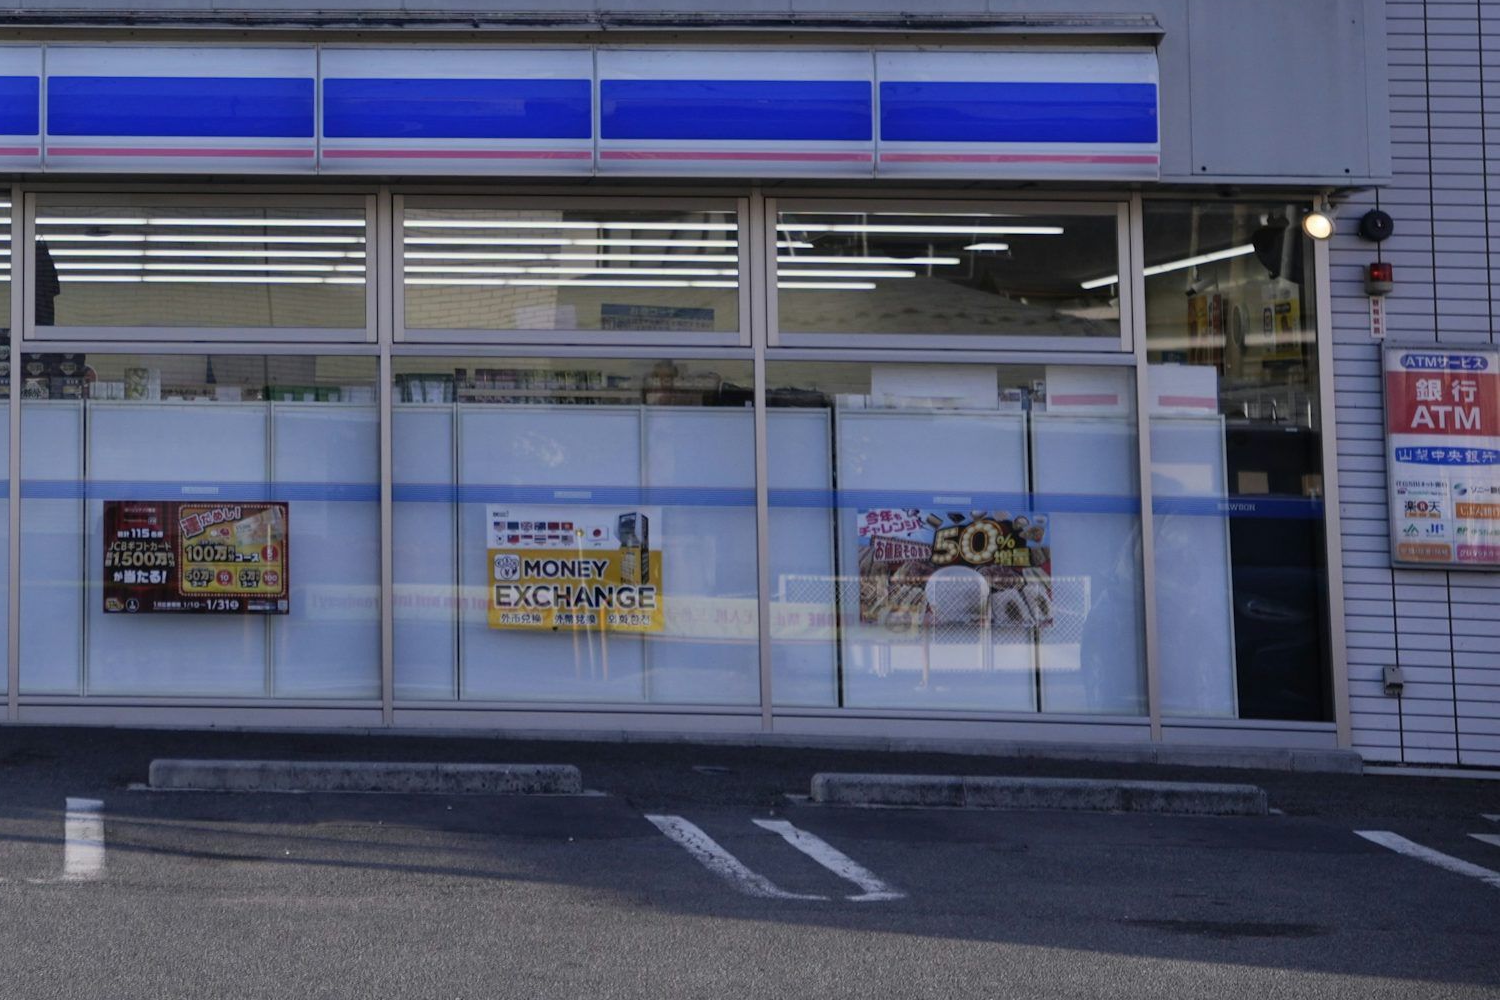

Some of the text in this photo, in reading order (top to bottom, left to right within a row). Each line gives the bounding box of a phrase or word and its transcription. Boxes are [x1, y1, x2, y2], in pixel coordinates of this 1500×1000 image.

[1406, 356, 1484, 369] ATMサービス
[1415, 378, 1477, 403] 銀行
[1410, 405, 1481, 430] ATM
[1398, 449, 1496, 462] 山梨中央銀行
[866, 510, 902, 525] 今年も
[109, 542, 172, 551] JCBギフトカード
[875, 540, 932, 561] お値段そのまま
[524, 560, 607, 577] MONEY
[113, 570, 167, 584] が当たる!
[495, 585, 655, 608] EXCHANGE
